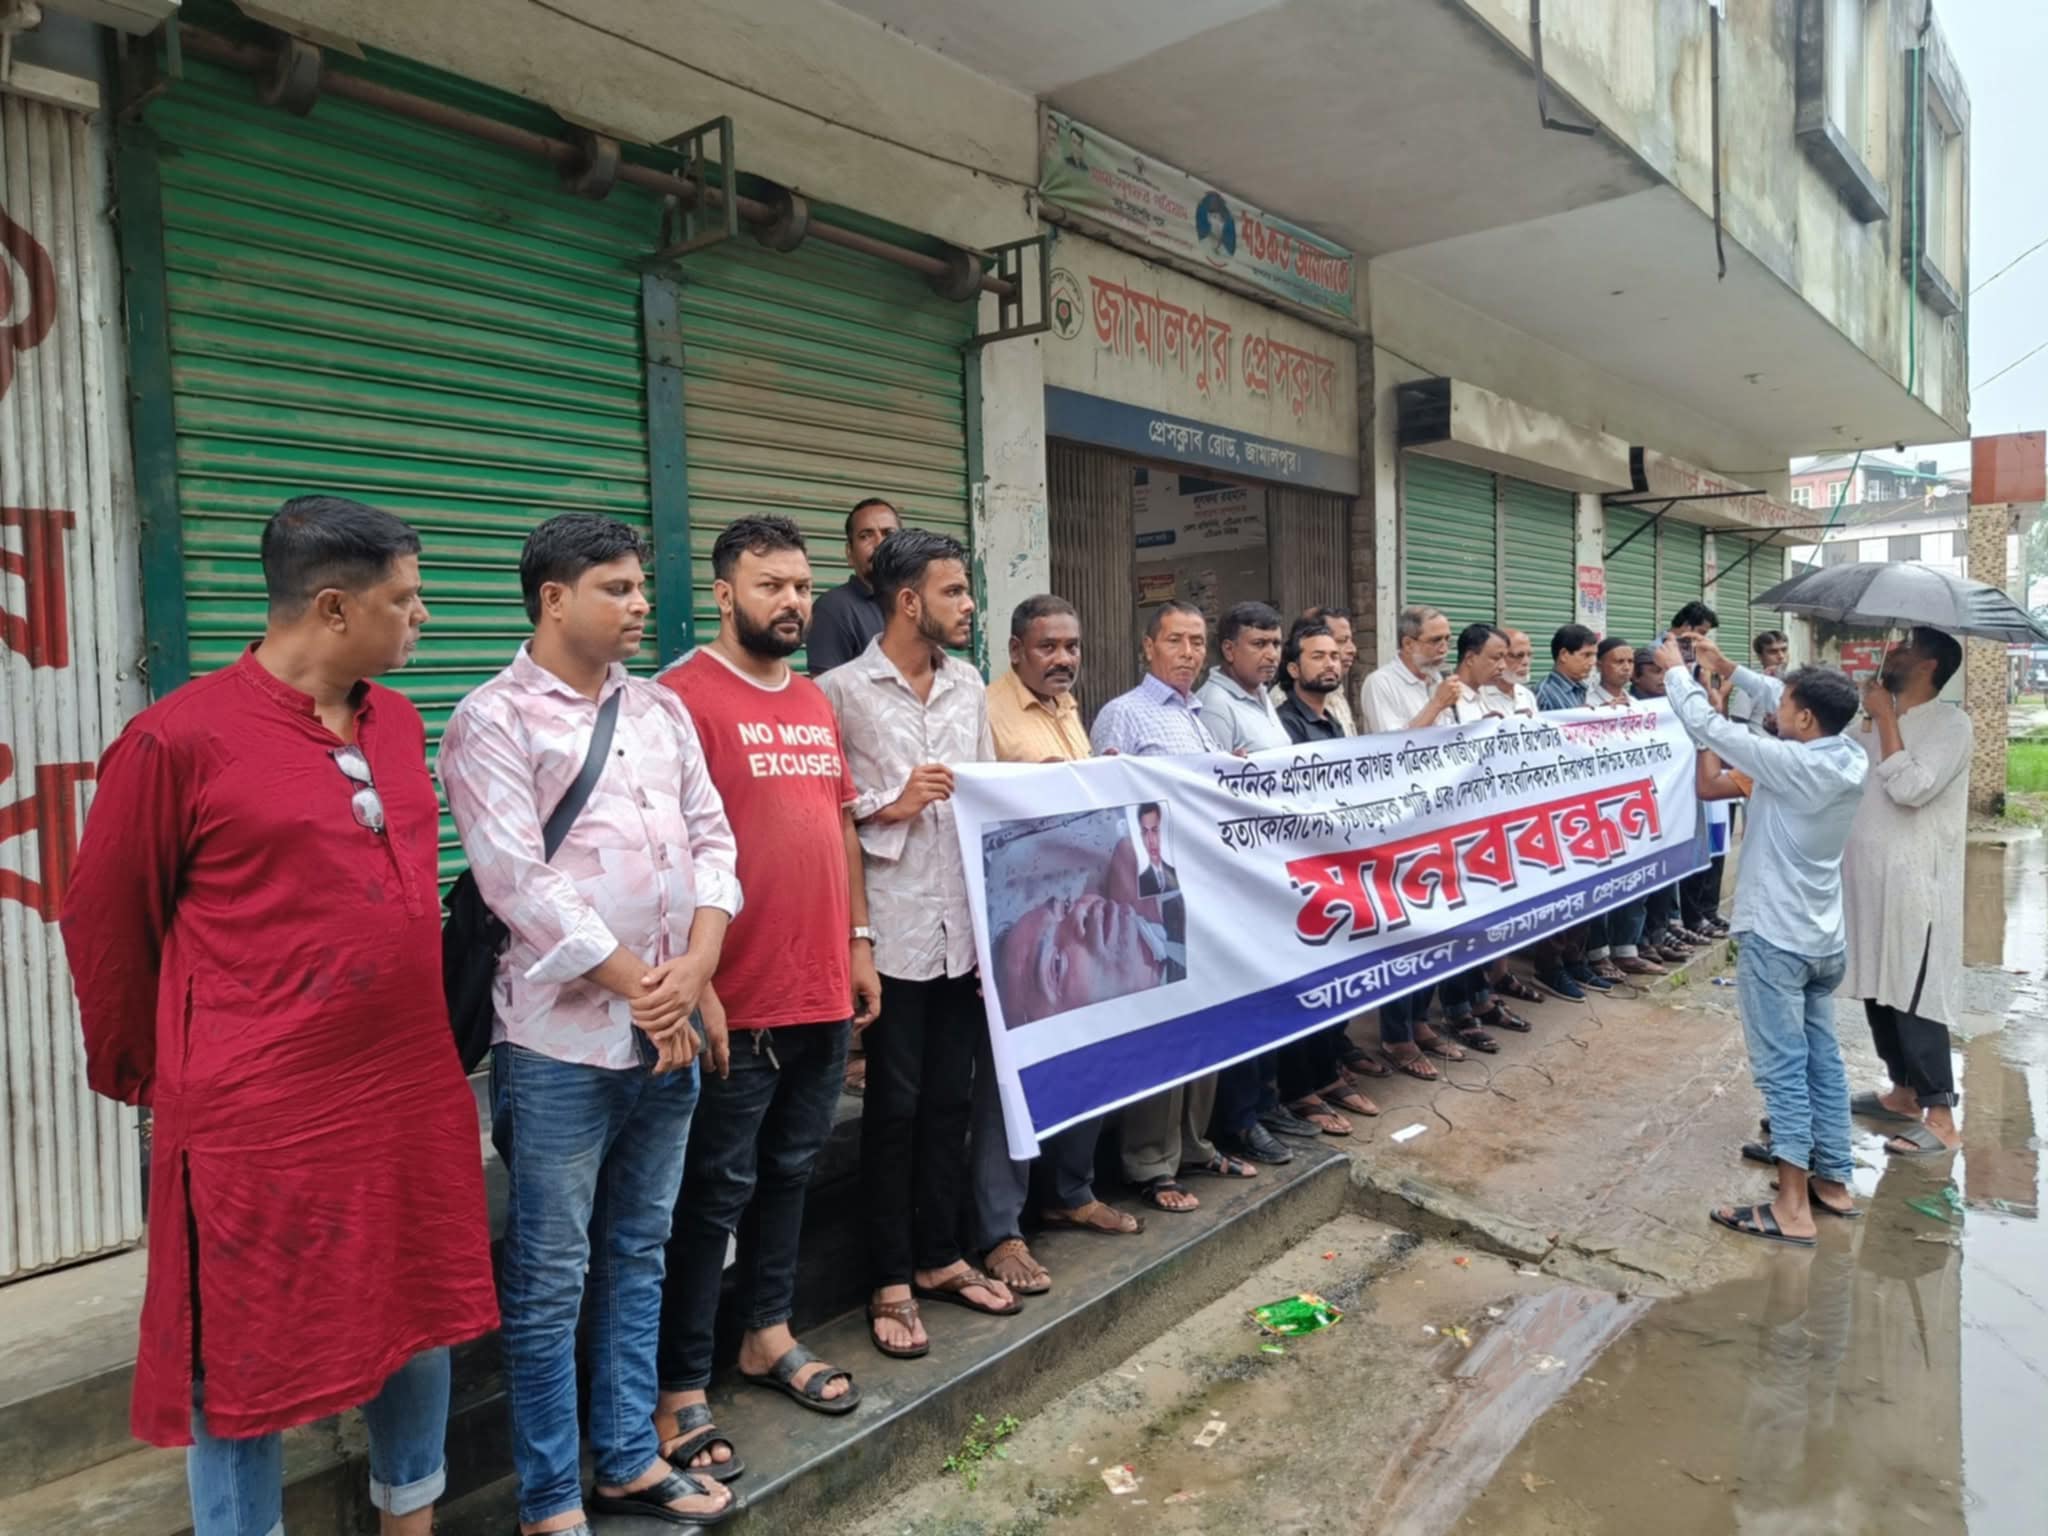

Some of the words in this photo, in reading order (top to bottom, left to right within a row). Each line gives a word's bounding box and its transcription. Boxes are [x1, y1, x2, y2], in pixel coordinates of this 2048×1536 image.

[1088, 275, 1232, 400] জামালপুর
[1242, 327, 1336, 417] প্রেসক্লাব
[1149, 420, 1203, 452] প্রেসক্লাব
[1208, 433, 1239, 462] রোড,
[737, 722, 773, 744] NO
[777, 724, 835, 746] MORE
[748, 752, 841, 776] EXCUSES
[1214, 762, 1275, 797] দৈনিক
[1281, 753, 1350, 795] প্রতিদিনের
[1355, 751, 1392, 781] কাগজ
[1396, 740, 1440, 774] পত্রিকার
[1442, 731, 1494, 764] গাজীপুরের
[1497, 728, 1518, 757] স্টাফ
[1520, 723, 1561, 750] রিপোর্টার
[1218, 806, 1333, 850] হত্যাকারীদের
[1456, 766, 1495, 805] দেশব্যাপী
[1497, 761, 1558, 797] সাংবাদিকদের
[1285, 777, 1661, 942] মানববন্ধন
[1297, 938, 1459, 1007] আয়োজনে
[1485, 889, 1585, 942] জামালপুর
